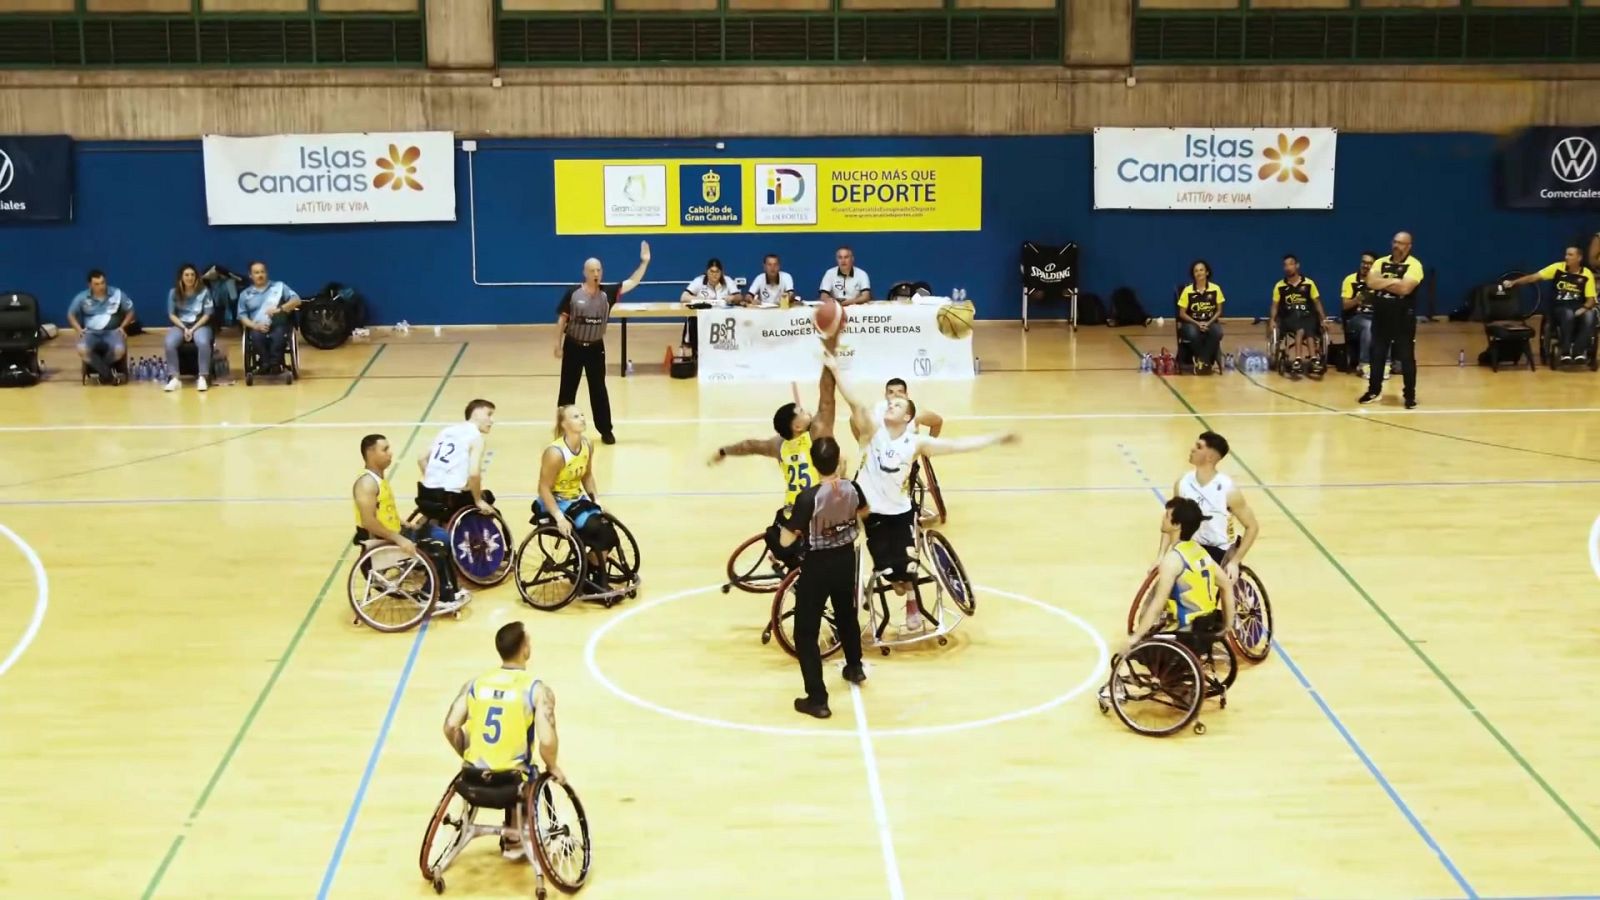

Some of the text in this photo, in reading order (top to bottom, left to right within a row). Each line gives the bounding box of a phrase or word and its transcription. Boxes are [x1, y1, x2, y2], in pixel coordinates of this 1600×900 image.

[1186, 134, 1254, 158] Islas
[299, 146, 367, 169] Islas
[831, 169, 936, 182] MUCHO MÁS QUE
[1117, 158, 1253, 183] Canarias
[238, 170, 368, 194] Canarias
[832, 184, 936, 203] DEPORTE
[1176, 192, 1252, 204] LATITUD DE VIDA
[296, 201, 369, 213] LATITUD DE VIDA
[1030, 265, 1071, 280] SPALDING
[761, 327, 817, 338] BALONCEST
[868, 326, 881, 334] DE
[883, 325, 921, 334] RUEDAS
[790, 317, 812, 327] LIGA
[862, 315, 892, 324] FEDDF
[433, 440, 456, 464] 12
[787, 462, 812, 492] 25
[482, 706, 504, 745] 5
